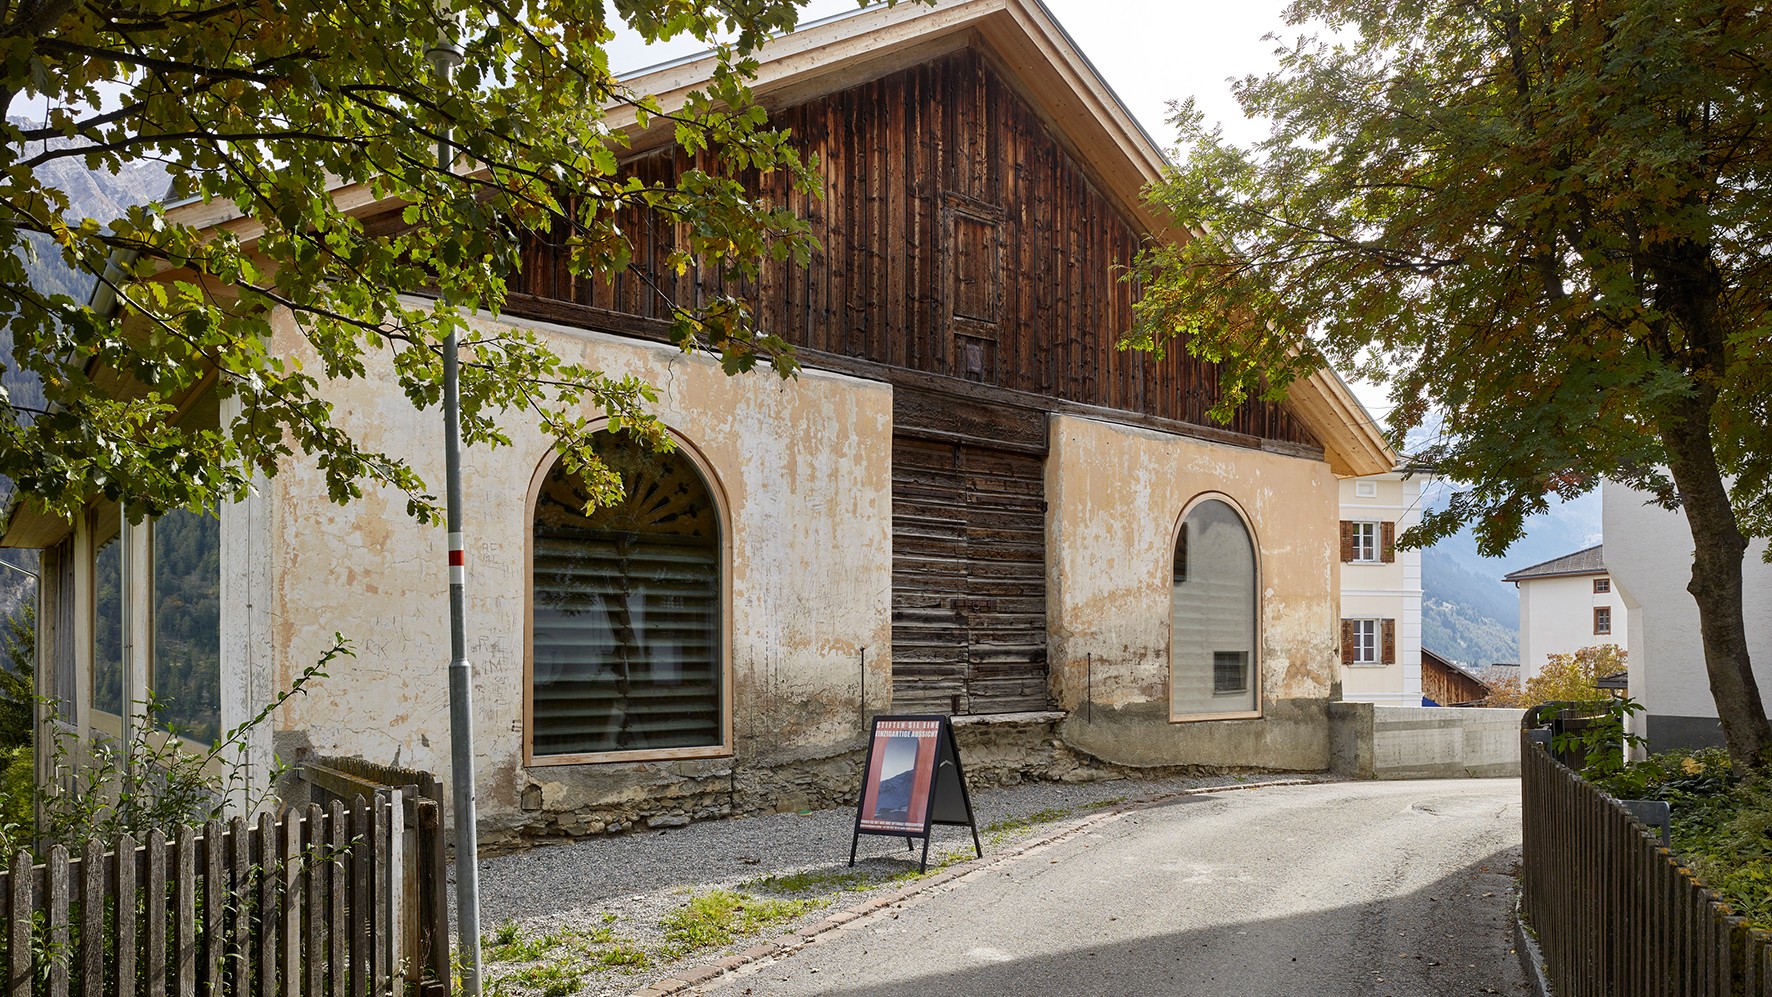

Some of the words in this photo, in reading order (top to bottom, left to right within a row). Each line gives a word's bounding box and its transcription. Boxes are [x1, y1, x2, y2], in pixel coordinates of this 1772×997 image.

[876, 721, 905, 729] STIFTEN
[908, 721, 920, 729] SIE
[923, 721, 939, 729] EINE
[875, 730, 911, 738] EINZIGARTIGE
[911, 730, 938, 738] AUSSICHT
